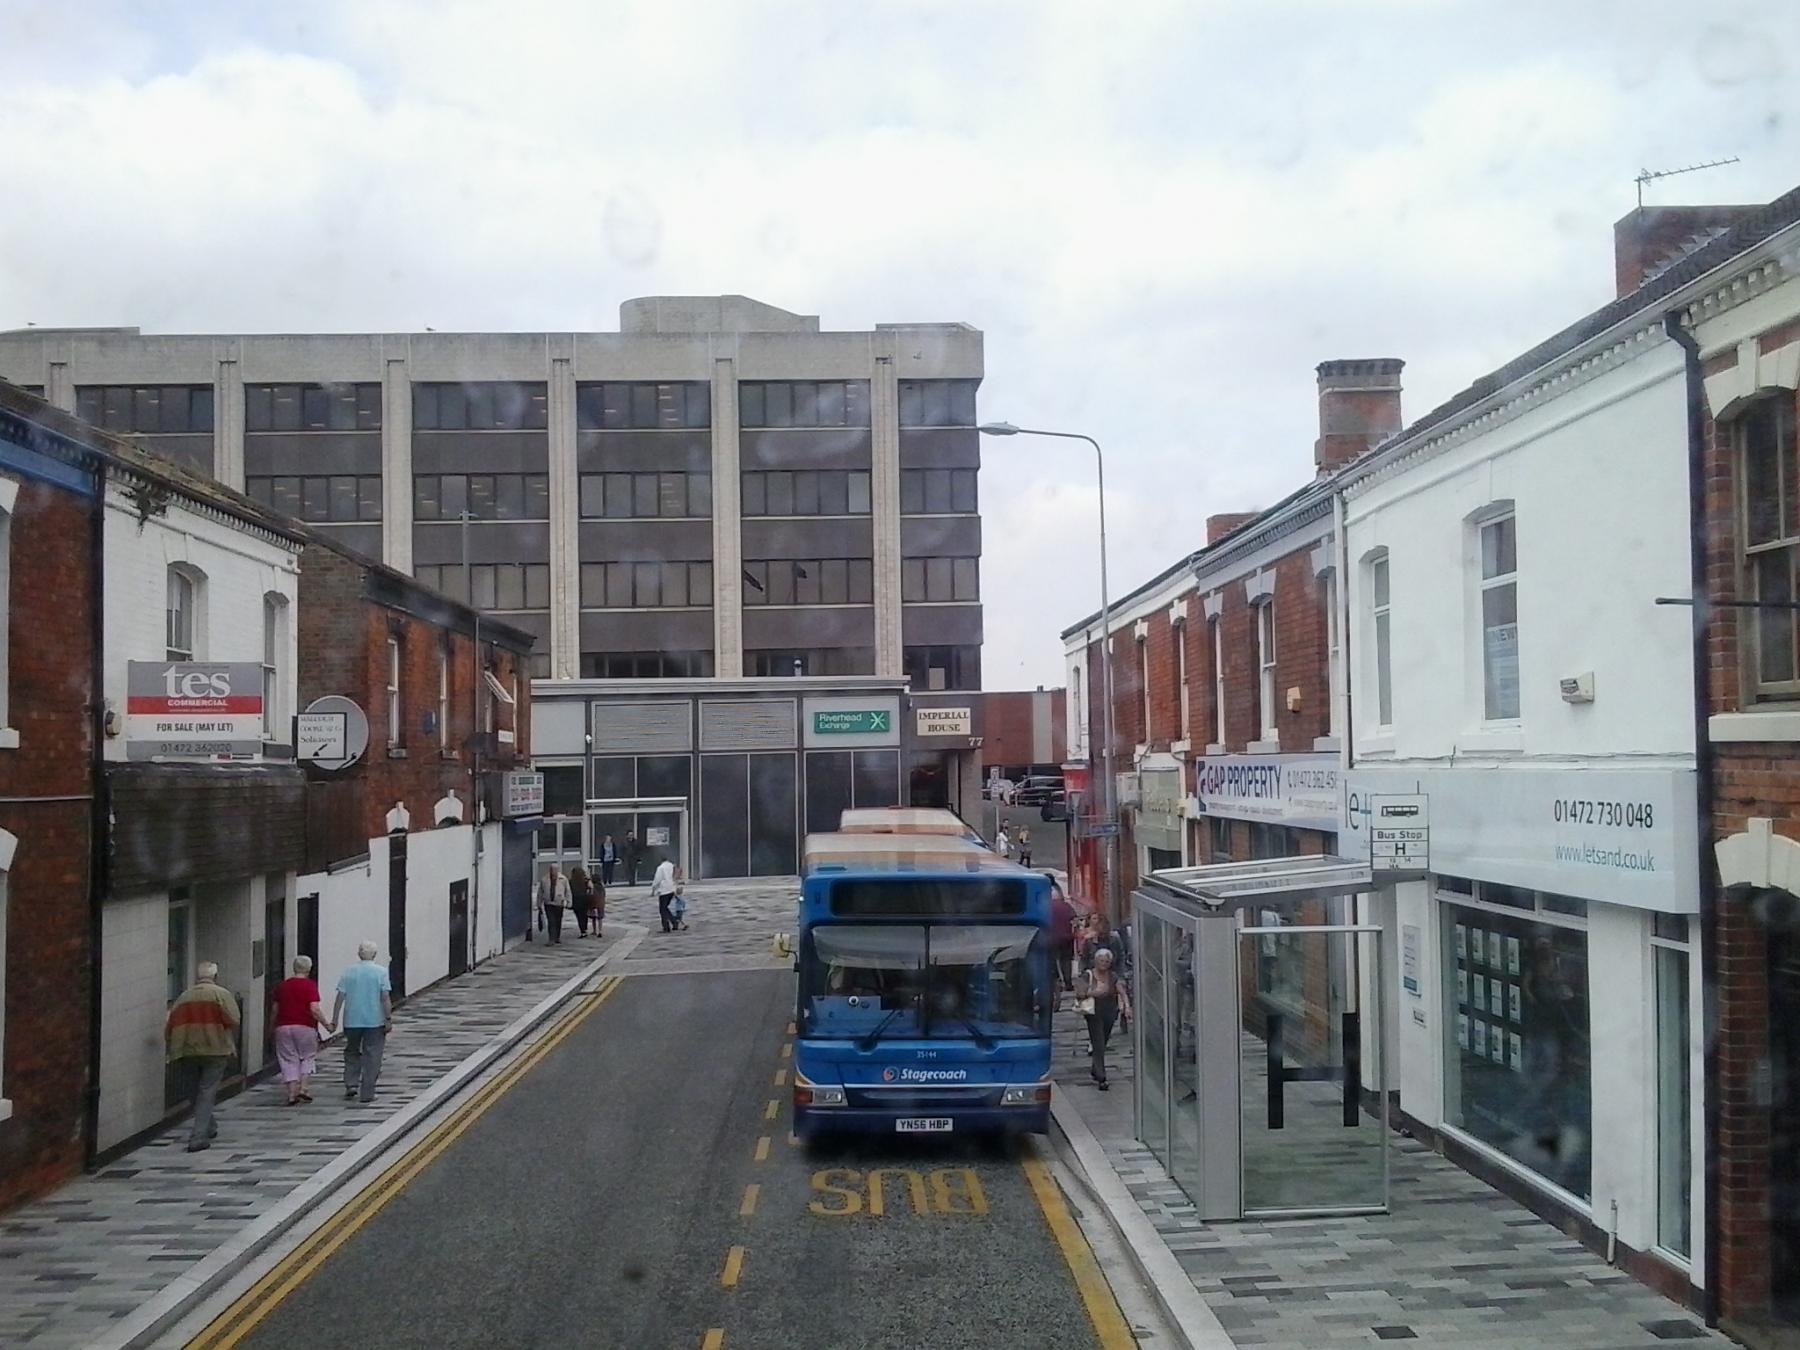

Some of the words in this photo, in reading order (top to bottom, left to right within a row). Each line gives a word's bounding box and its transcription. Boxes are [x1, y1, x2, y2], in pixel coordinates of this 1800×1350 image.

[162, 664, 231, 698] tes
[819, 713, 863, 722] Riverhead
[918, 711, 969, 720] IMPERIAL
[156, 723, 172, 732] FOR
[174, 723, 194, 732] SALE
[195, 723, 216, 733] (MAY
[217, 723, 234, 733] LET)
[927, 723, 961, 732] HOUSE
[968, 737, 984, 747] 77
[160, 743, 192, 753] 01472
[1207, 765, 1225, 796] GAP
[1227, 764, 1282, 800] PROPERTY
[1554, 799, 1594, 824] 01472
[1597, 801, 1623, 827] 730
[1626, 802, 1653, 829] 048
[1377, 831, 1396, 839] Bus
[1399, 830, 1423, 840] Stop
[1394, 842, 1406, 855] H
[1555, 842, 1655, 872] www.letsand.co.uk
[900, 1068, 967, 1082] Stagecoach
[900, 1119, 927, 1130] YN56
[808, 1168, 988, 1217] BUS
